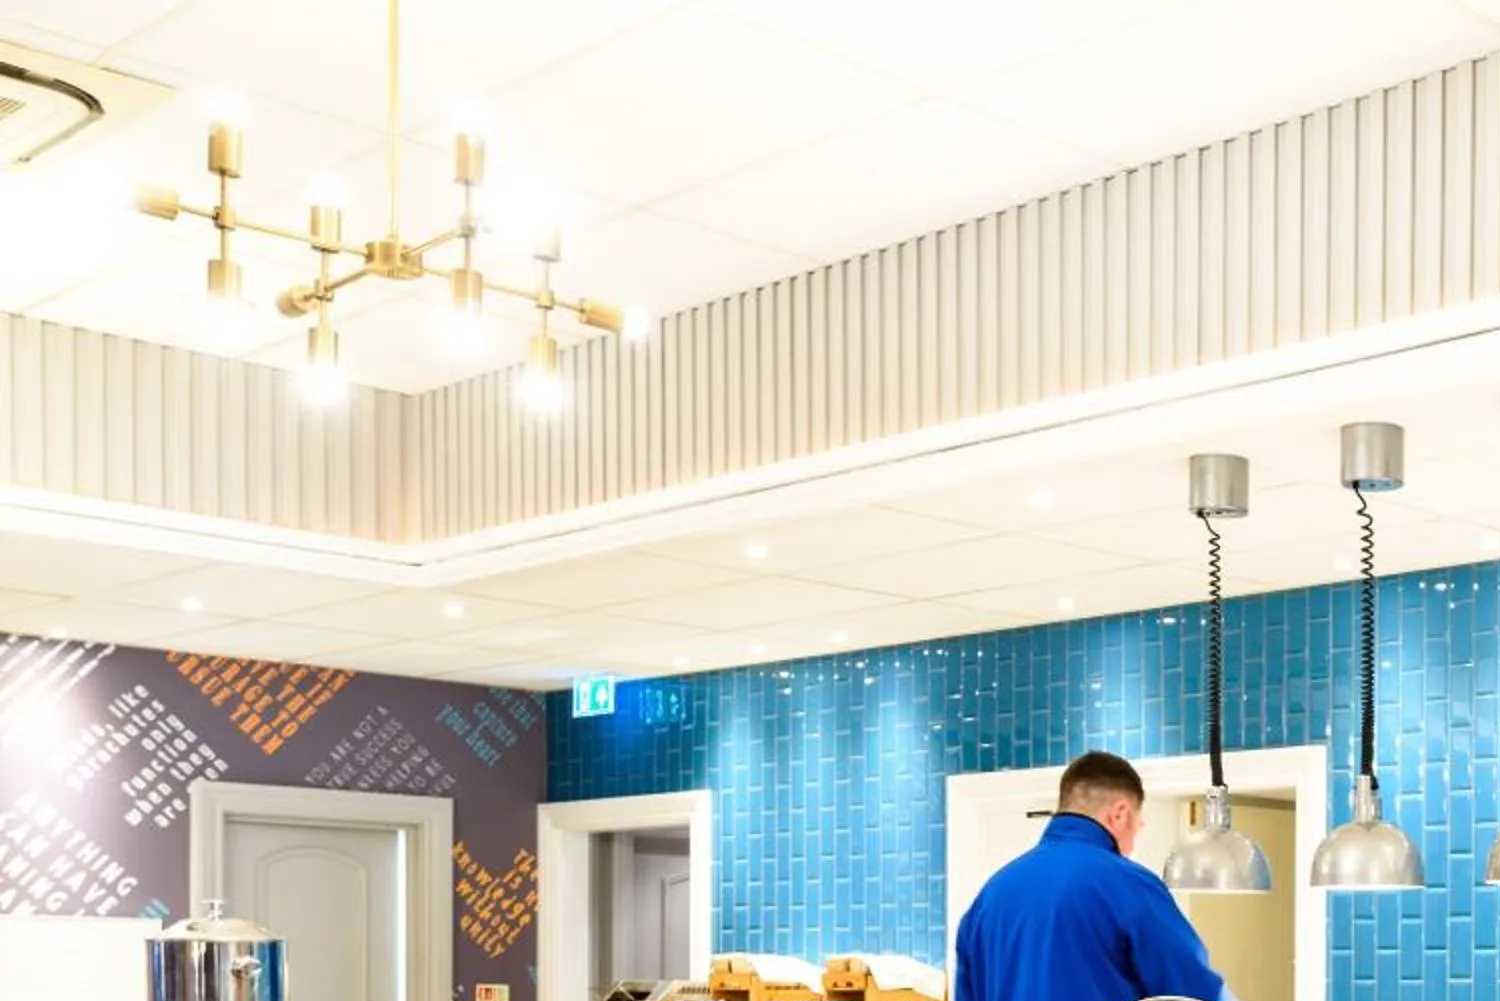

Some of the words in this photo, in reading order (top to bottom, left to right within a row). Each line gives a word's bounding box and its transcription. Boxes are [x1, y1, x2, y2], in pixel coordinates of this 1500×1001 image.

[108, 684, 149, 719] like
[141, 713, 186, 751] only
[66, 699, 166, 793] parachutes
[120, 729, 198, 797] function
[357, 754, 394, 789] NLESS
[124, 782, 173, 827] when
[168, 743, 217, 781] they
[153, 797, 187, 828] are
[13, 791, 139, 897] ANYTHING
[47, 854, 120, 916] HAVE
